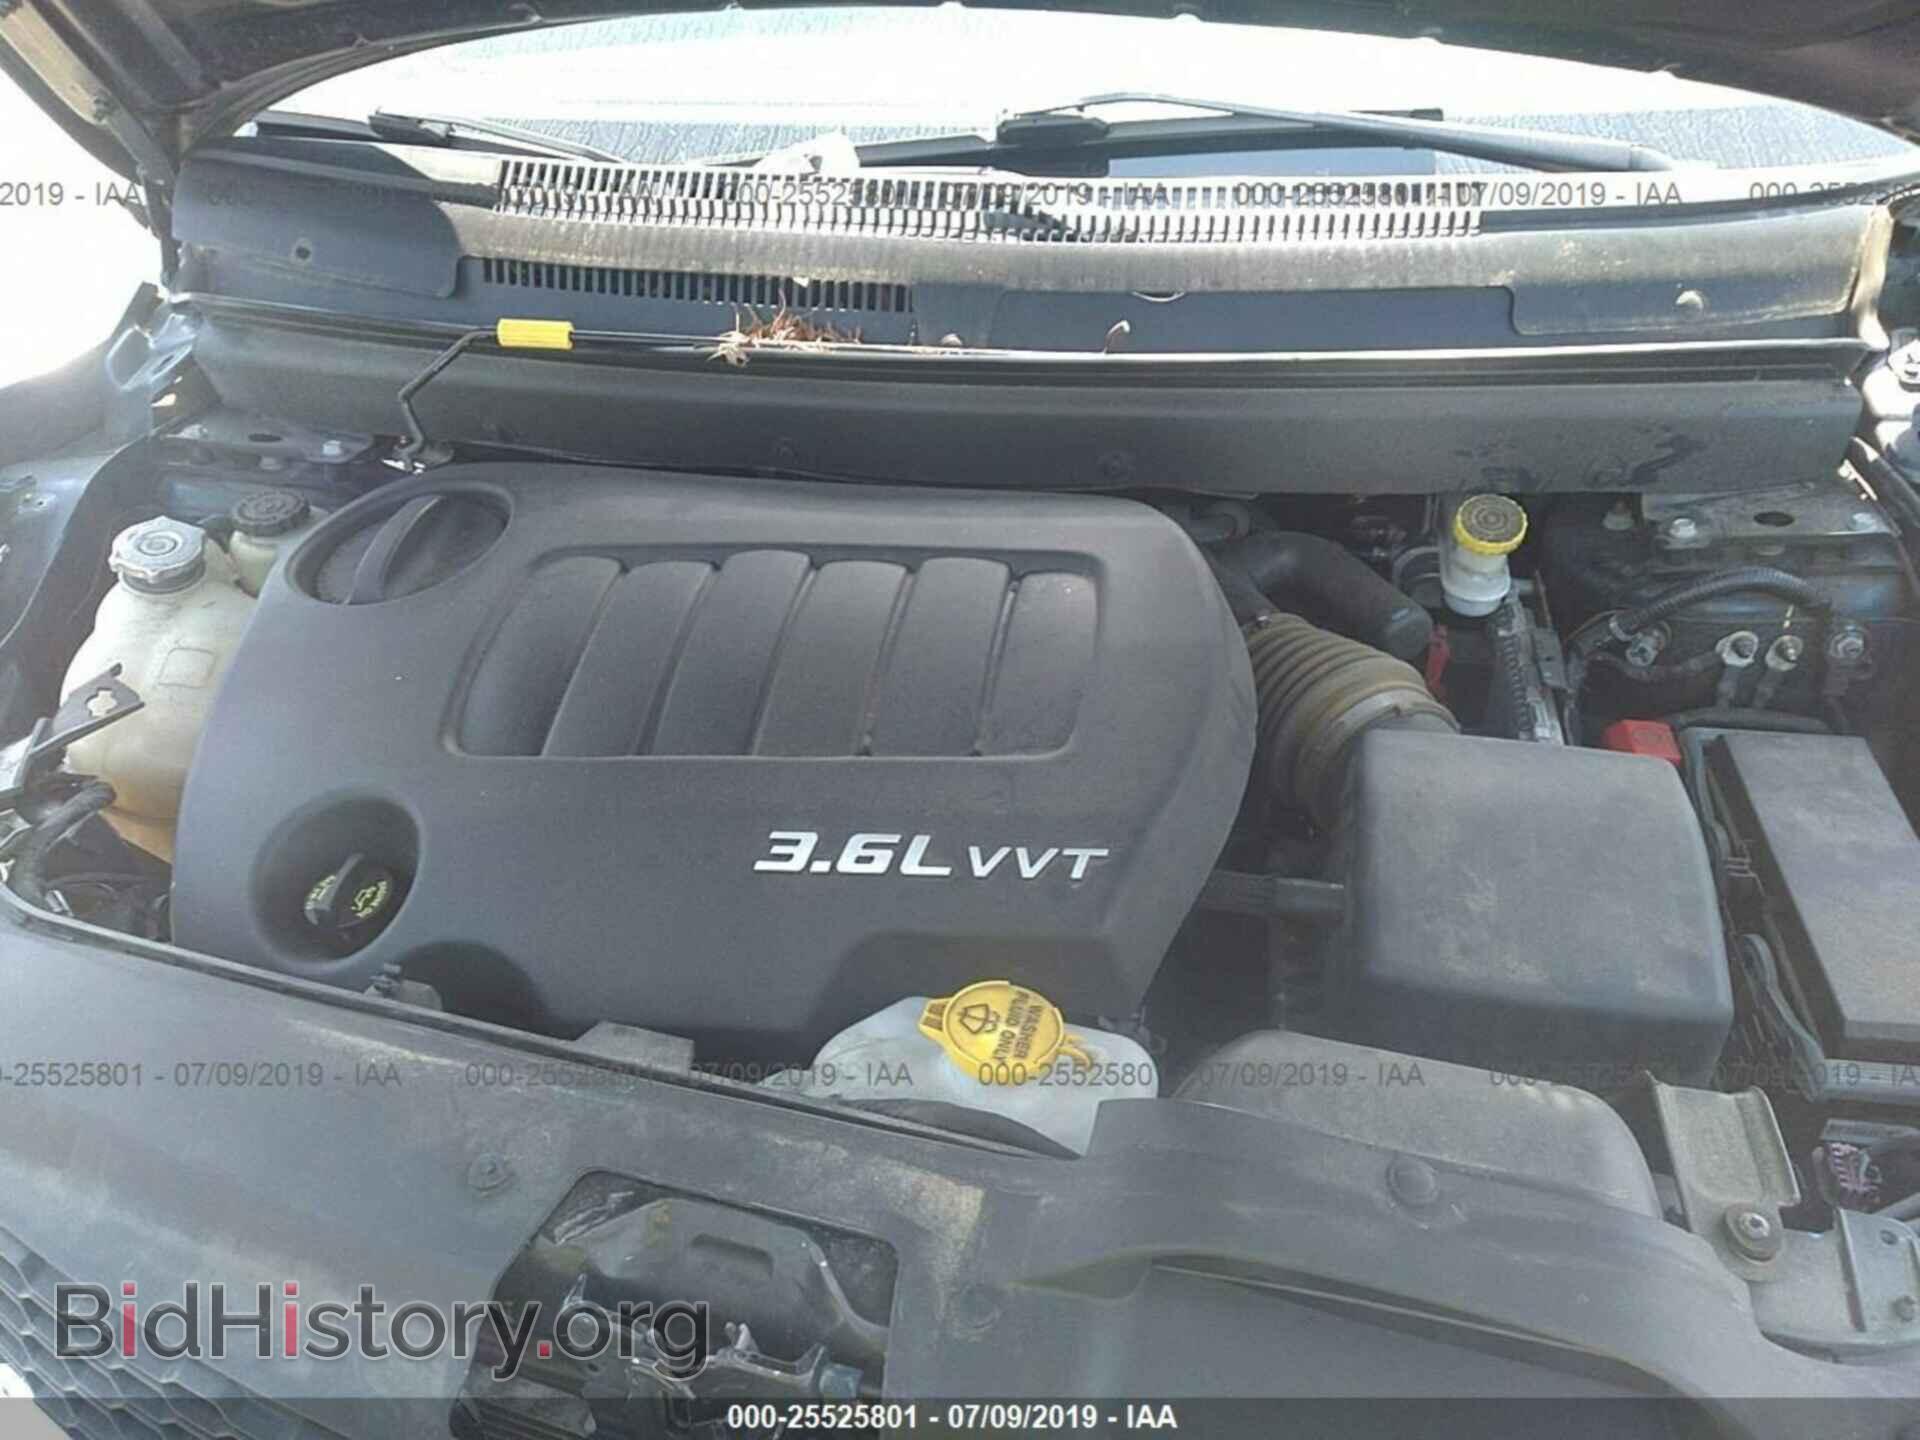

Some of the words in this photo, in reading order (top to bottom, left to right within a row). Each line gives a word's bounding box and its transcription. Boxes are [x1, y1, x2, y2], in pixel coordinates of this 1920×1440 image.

[754, 831, 952, 876] 3.6L
[968, 846, 1109, 880] VVT
[1013, 1004, 1044, 1059] WASHER
